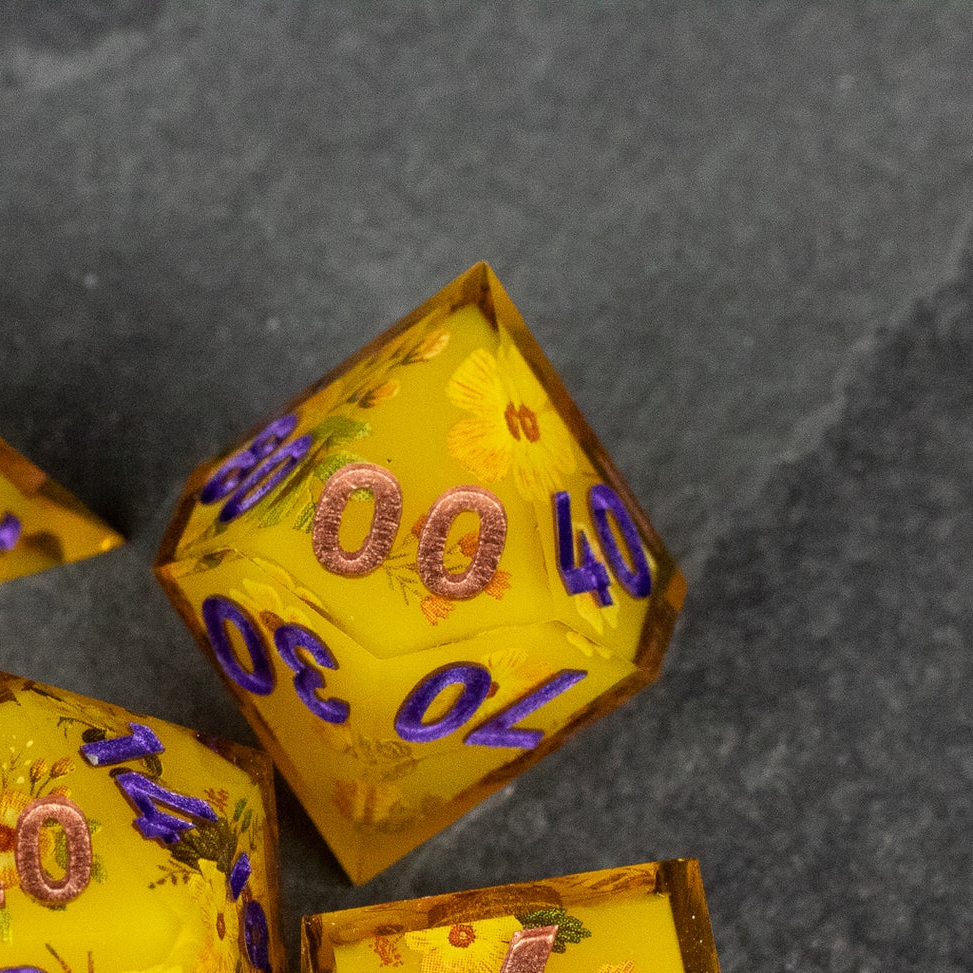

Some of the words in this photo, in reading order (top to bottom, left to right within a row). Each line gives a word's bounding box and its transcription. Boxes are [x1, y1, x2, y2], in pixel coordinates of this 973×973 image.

[311, 462, 508, 601] 00
[552, 483, 654, 610] 40
[200, 594, 351, 726] 30
[393, 660, 589, 750] 70
